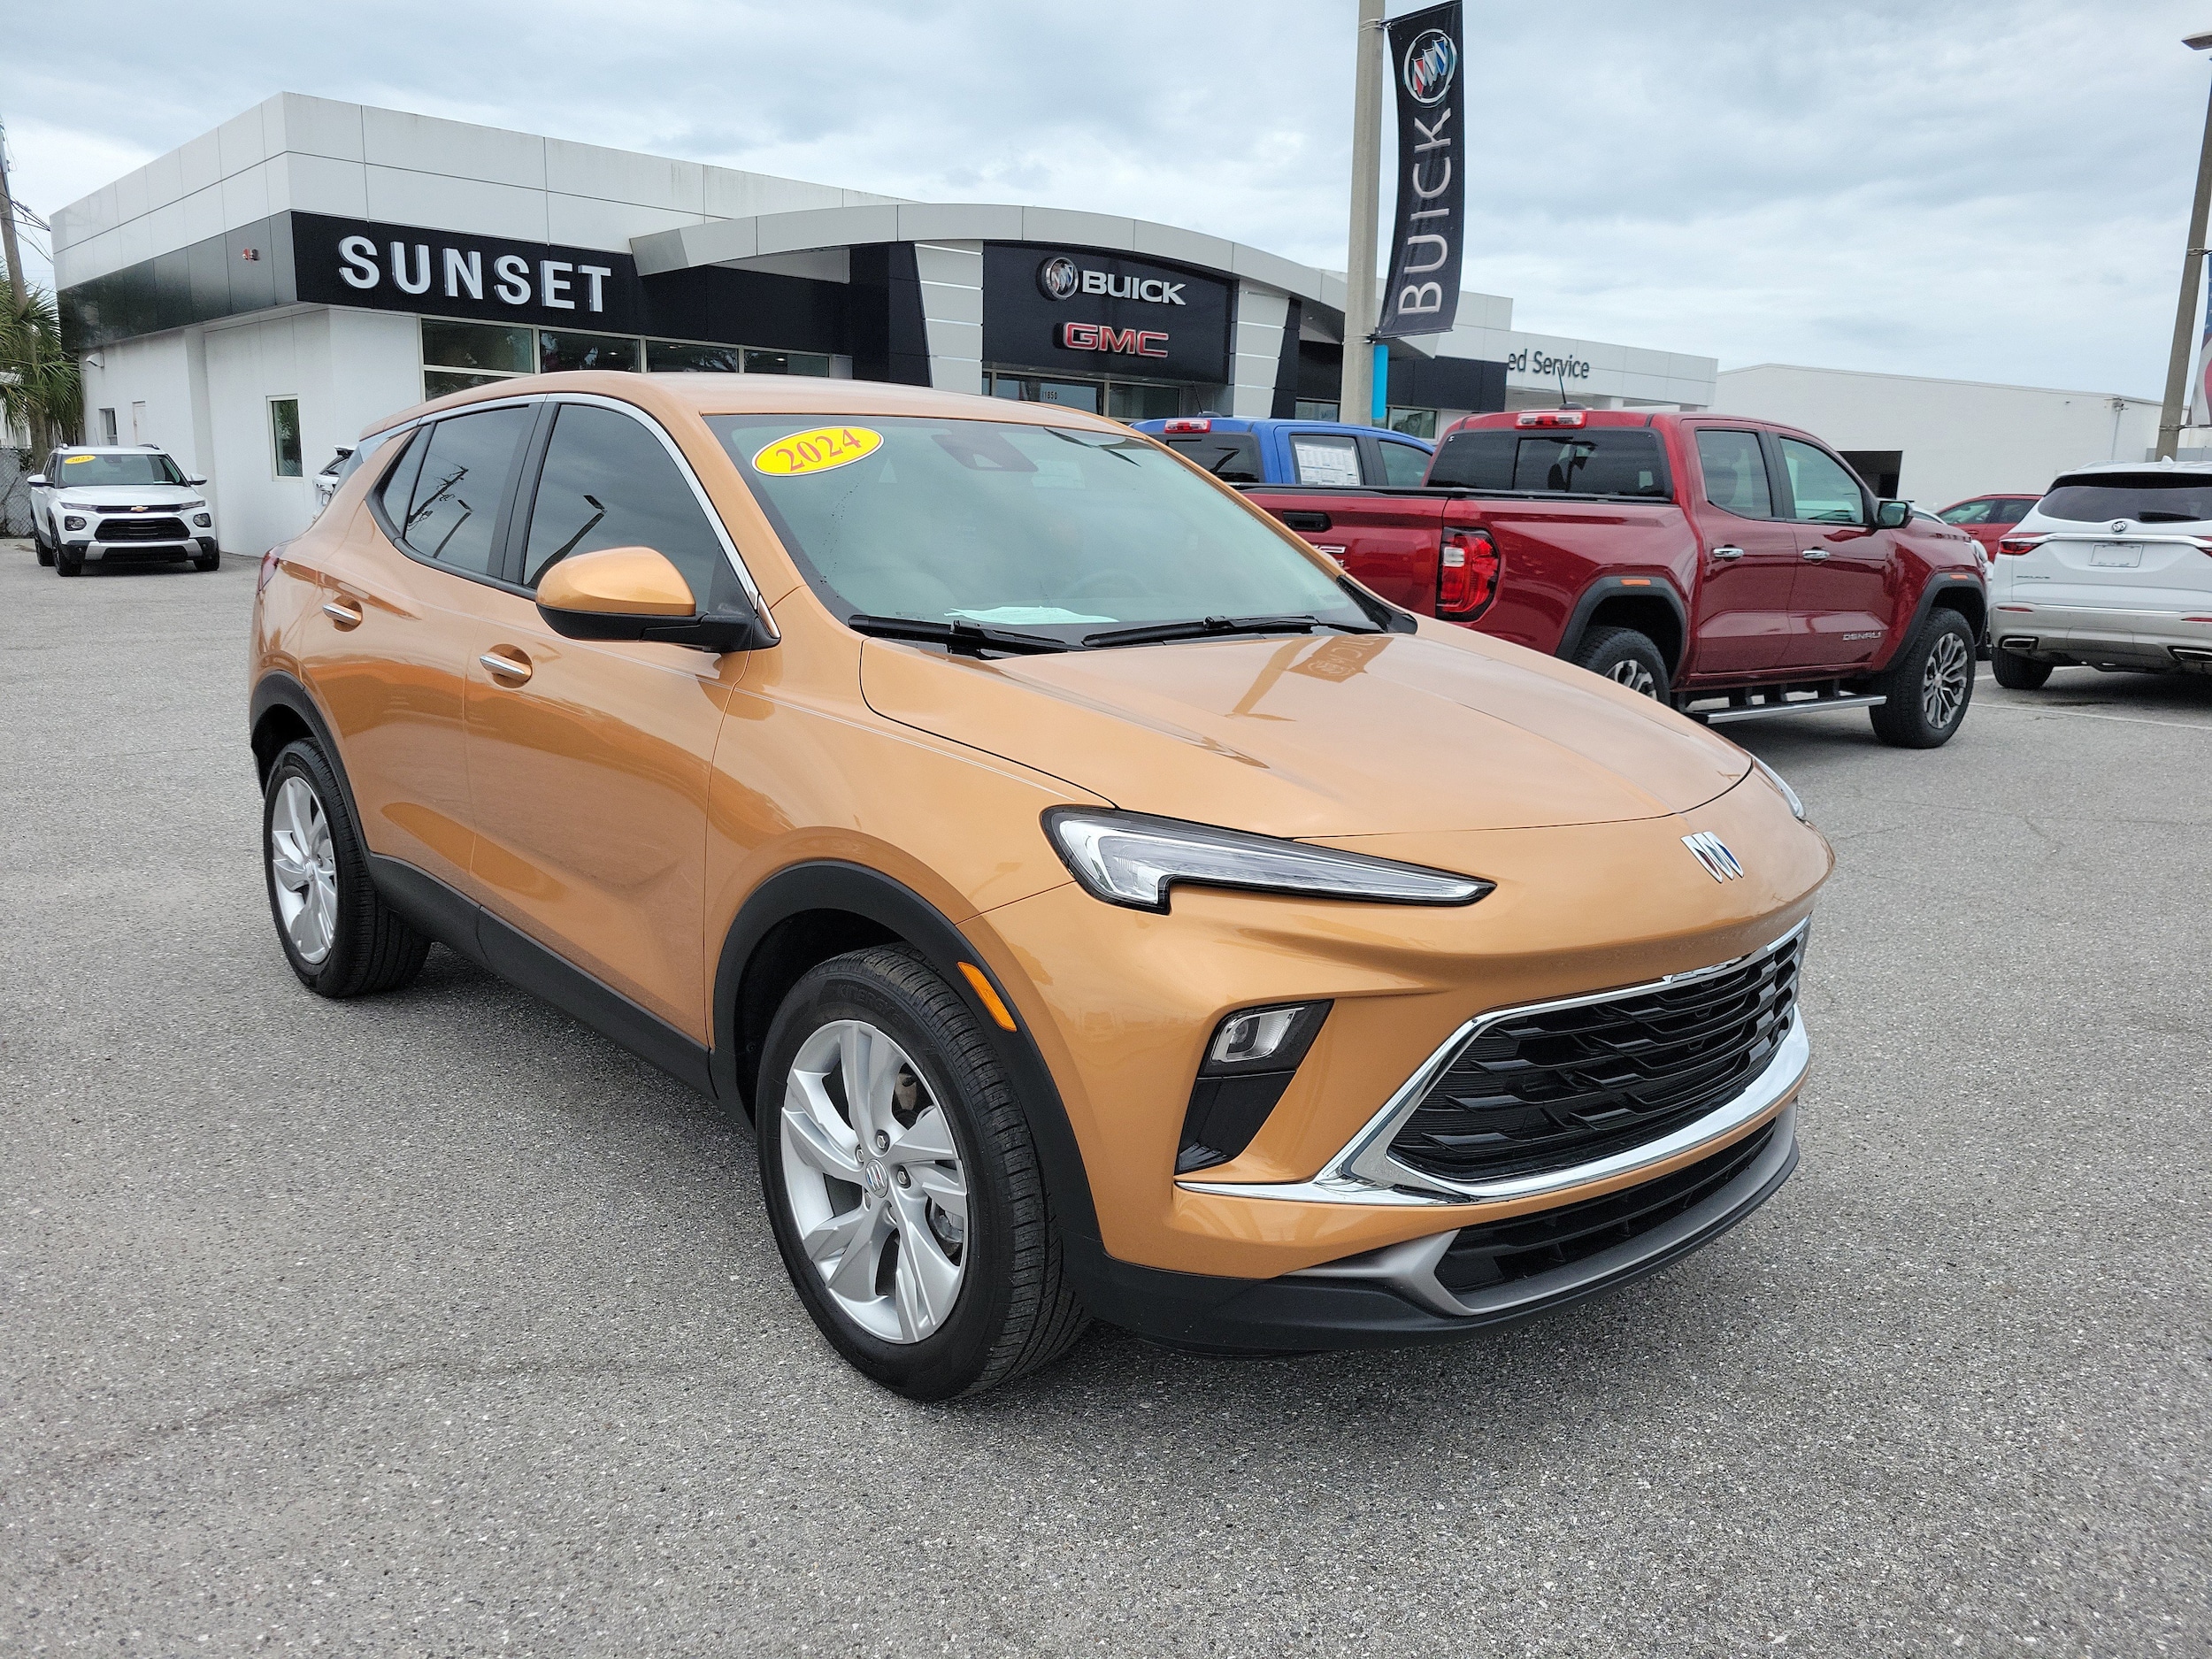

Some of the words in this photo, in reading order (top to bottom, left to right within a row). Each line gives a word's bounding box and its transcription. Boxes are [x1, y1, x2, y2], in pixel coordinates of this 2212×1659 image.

[1397, 108, 1452, 315] BUICK
[338, 234, 611, 312] SUNSET
[1082, 270, 1187, 306] BUICK
[1064, 321, 1169, 357] GMC
[1532, 350, 1590, 380] Service
[776, 429, 863, 472] 2024
